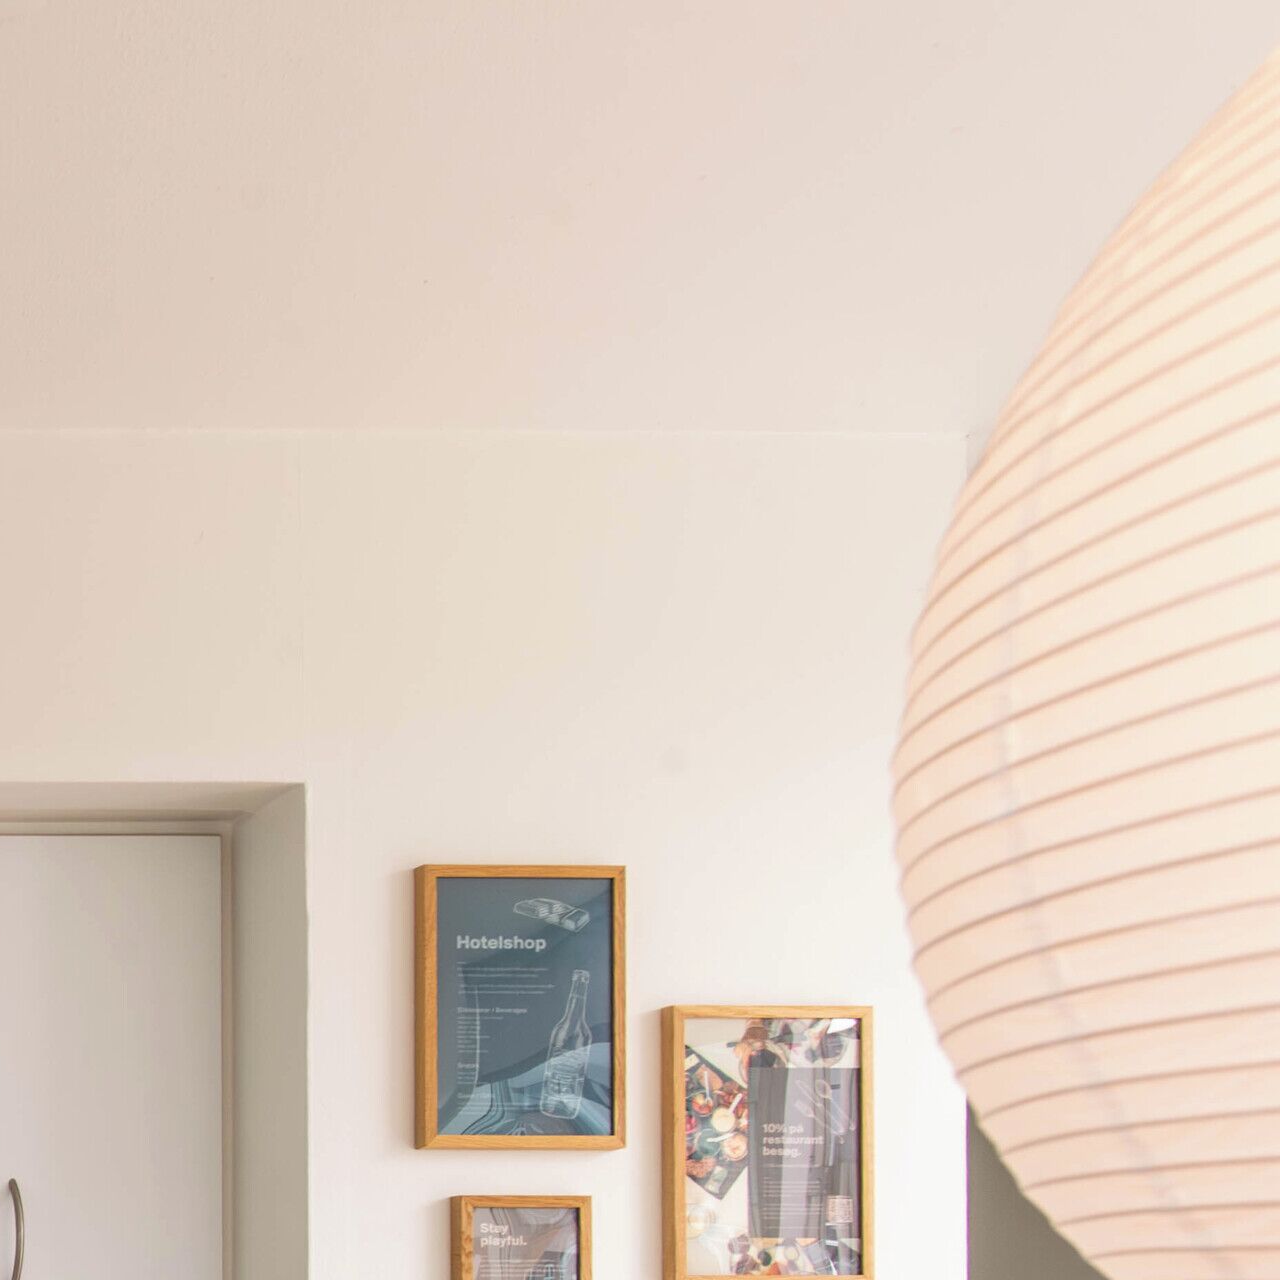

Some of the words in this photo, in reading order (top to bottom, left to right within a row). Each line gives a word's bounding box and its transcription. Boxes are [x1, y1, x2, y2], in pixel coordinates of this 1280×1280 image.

[456, 935, 547, 953] Hotelshop
[762, 1123, 787, 1133] 10%
[762, 1136, 825, 1145] restaurant
[480, 1223, 509, 1235] Stay
[480, 1236, 528, 1248] playful.
